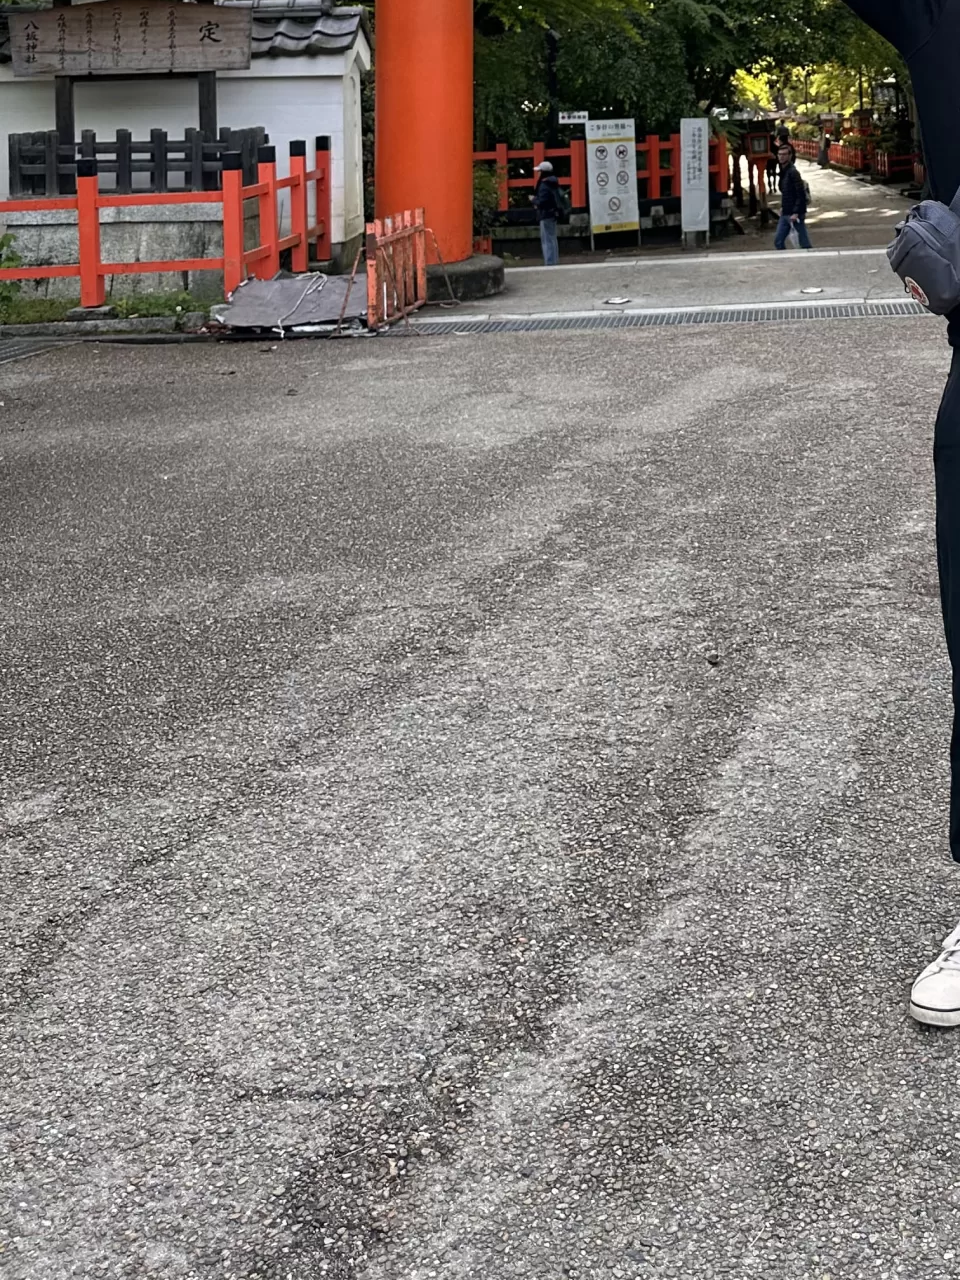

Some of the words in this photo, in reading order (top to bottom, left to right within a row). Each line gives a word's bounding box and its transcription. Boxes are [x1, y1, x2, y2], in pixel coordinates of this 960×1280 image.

[24, 20, 40, 64] 八坂神社
[198, 20, 222, 43] 定
